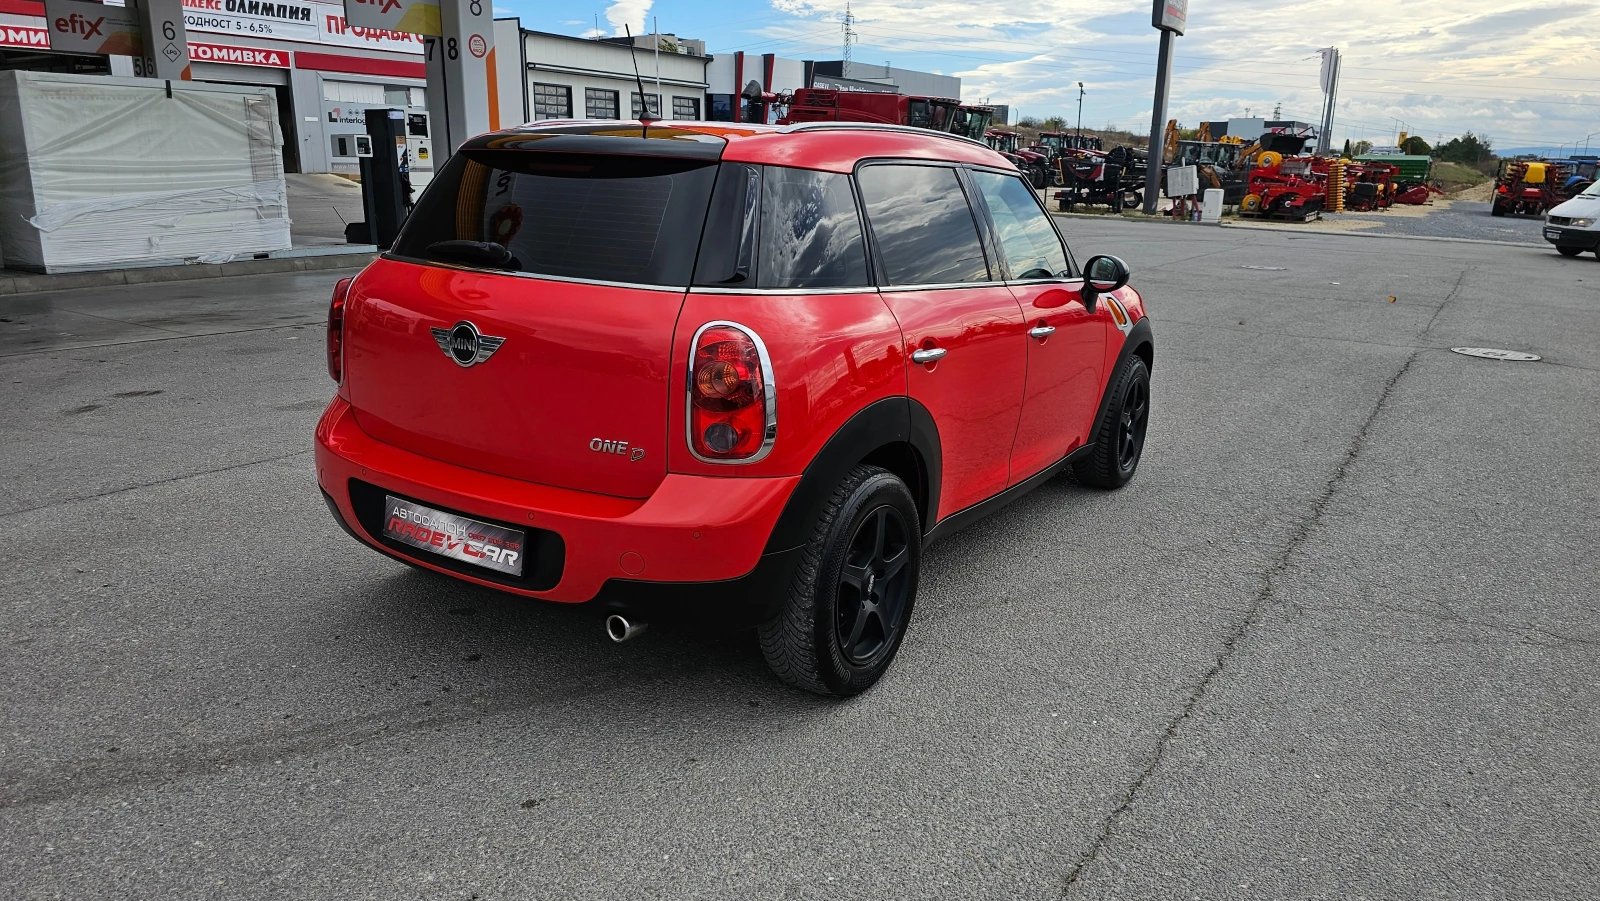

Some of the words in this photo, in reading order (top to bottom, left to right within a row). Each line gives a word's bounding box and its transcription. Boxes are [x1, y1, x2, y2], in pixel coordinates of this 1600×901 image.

[225, 0, 311, 21] ОЛИМПИЯ
[55, 13, 105, 40] efix
[162, 20, 176, 40] 6
[236, 22, 242, 30] 5
[249, 23, 273, 33] 6,5%
[0, 28, 51, 46] МИ
[426, 39, 436, 61] 7
[447, 37, 459, 60] 8
[134, 59, 142, 75] 5
[147, 57, 154, 75] 6
[451, 337, 475, 351] MINI
[590, 438, 628, 455] ONE
[631, 447, 645, 461] D
[393, 506, 466, 536] АВТОСАЛОН
